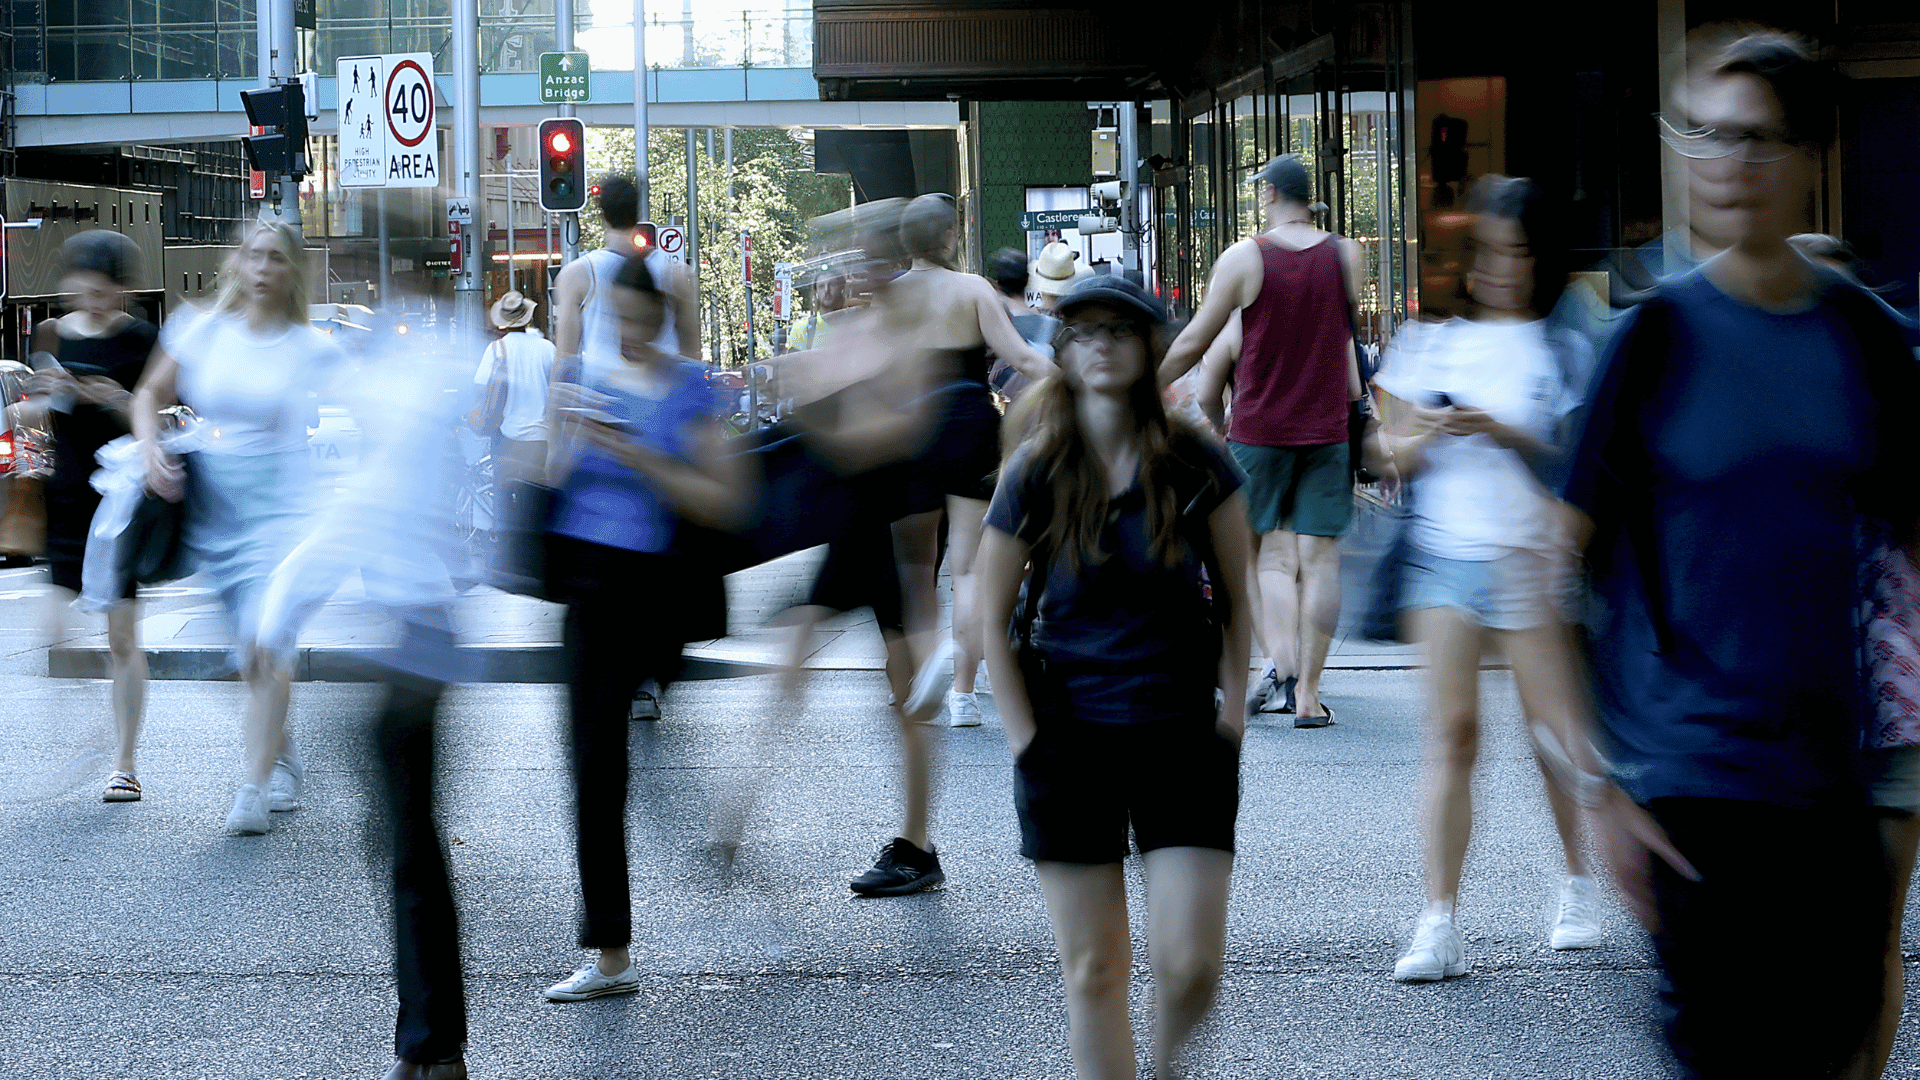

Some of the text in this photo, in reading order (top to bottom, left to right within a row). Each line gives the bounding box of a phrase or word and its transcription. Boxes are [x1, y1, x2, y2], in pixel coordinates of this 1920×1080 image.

[545, 75, 585, 85] Anzac
[545, 88, 585, 100] Bridge
[392, 83, 427, 124] 40
[354, 147, 370, 156] HIGH
[388, 153, 436, 179] AREA
